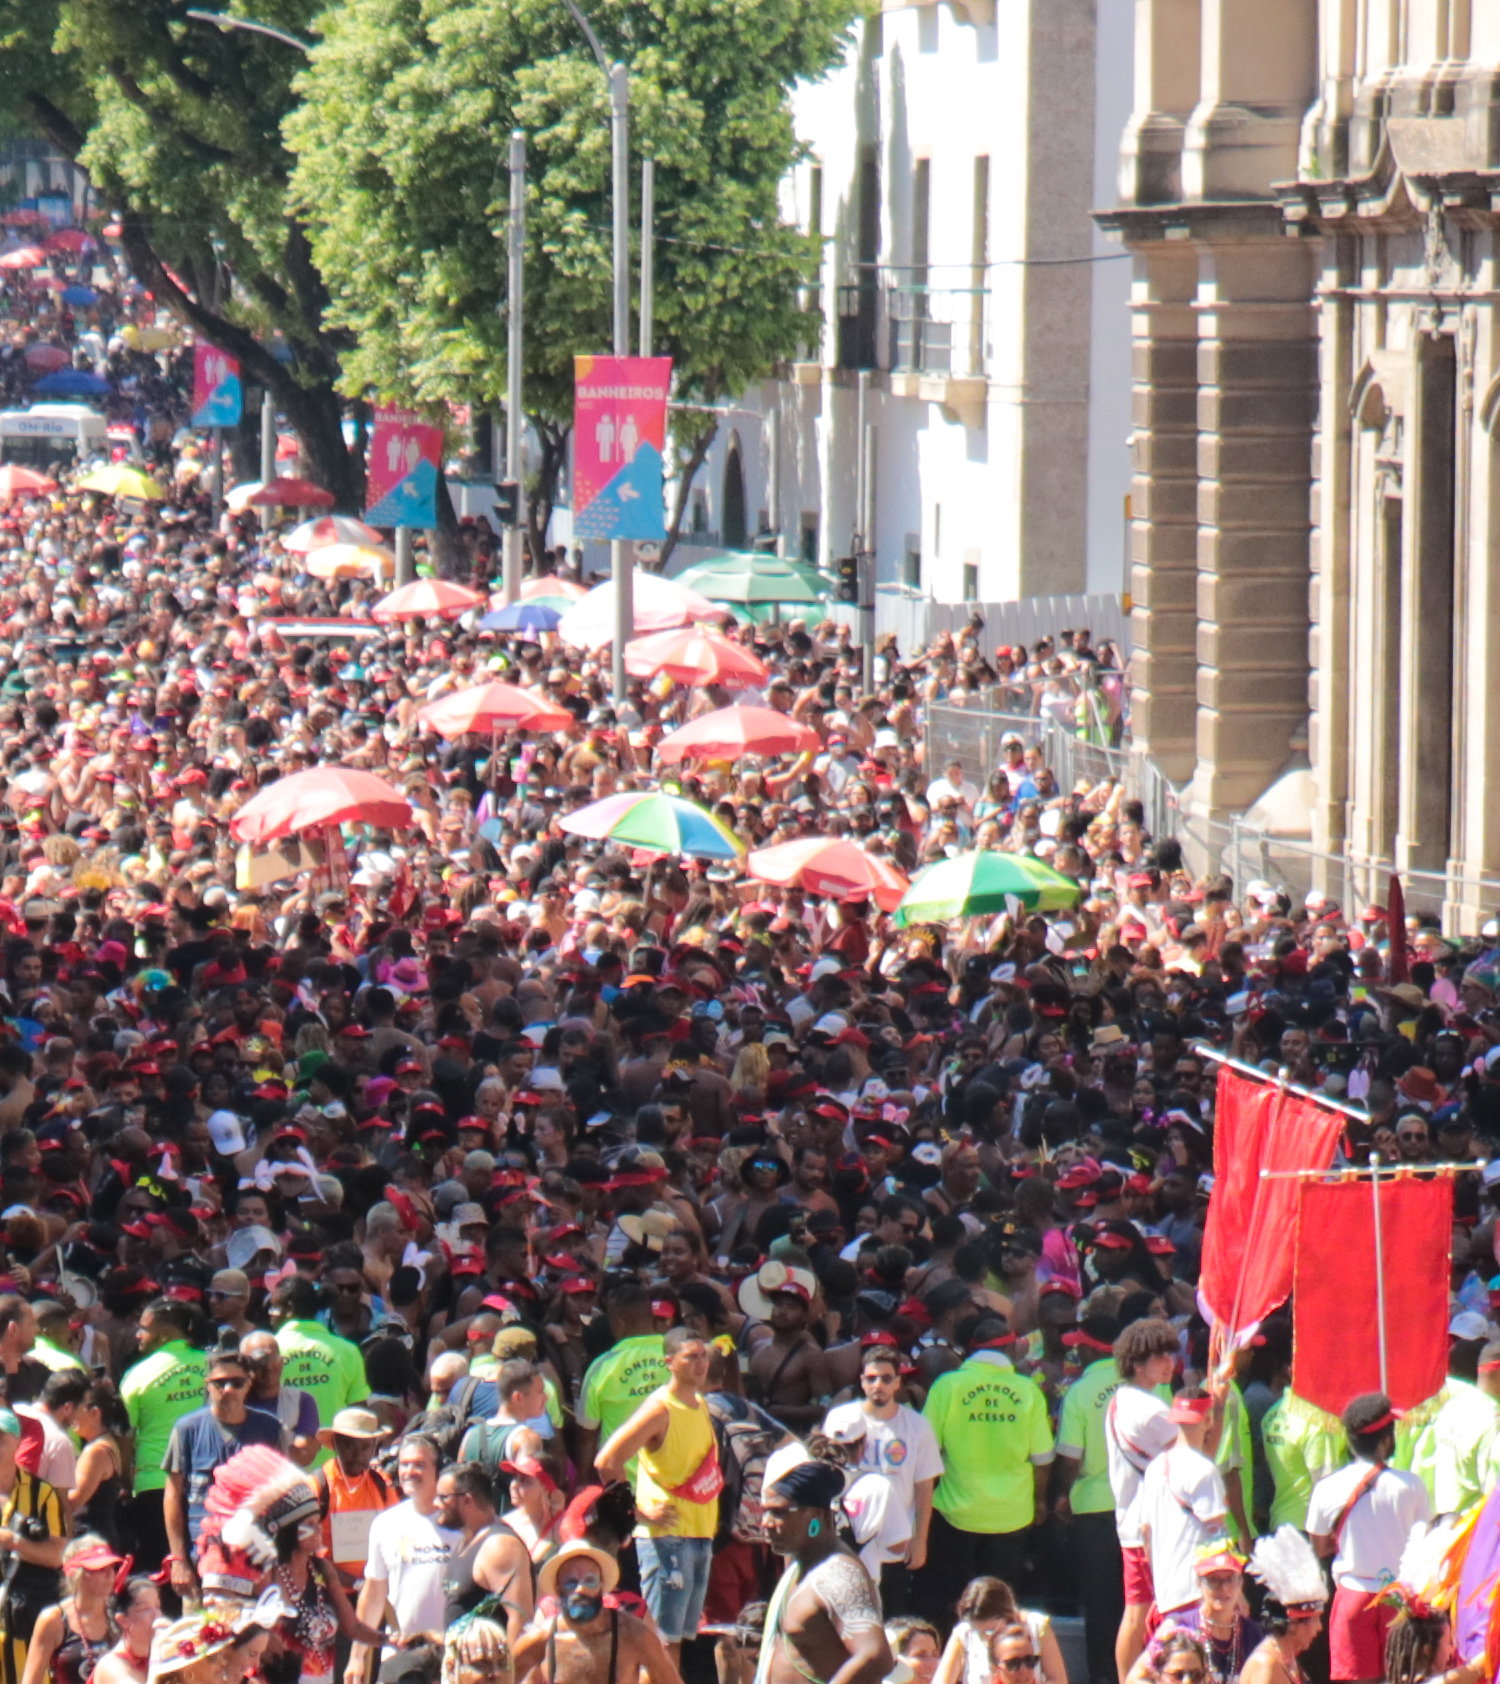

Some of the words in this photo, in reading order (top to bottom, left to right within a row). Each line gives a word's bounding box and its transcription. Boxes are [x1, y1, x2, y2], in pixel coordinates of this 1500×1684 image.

[577, 386, 664, 399] BANHEIROS
[299, 1363, 312, 1373] DE
[283, 1373, 330, 1388] ACESSO
[642, 1371, 656, 1381] DE
[961, 1384, 1022, 1406] CONTROLE
[985, 1398, 999, 1408] DE
[968, 1412, 1017, 1423] ACESSO
